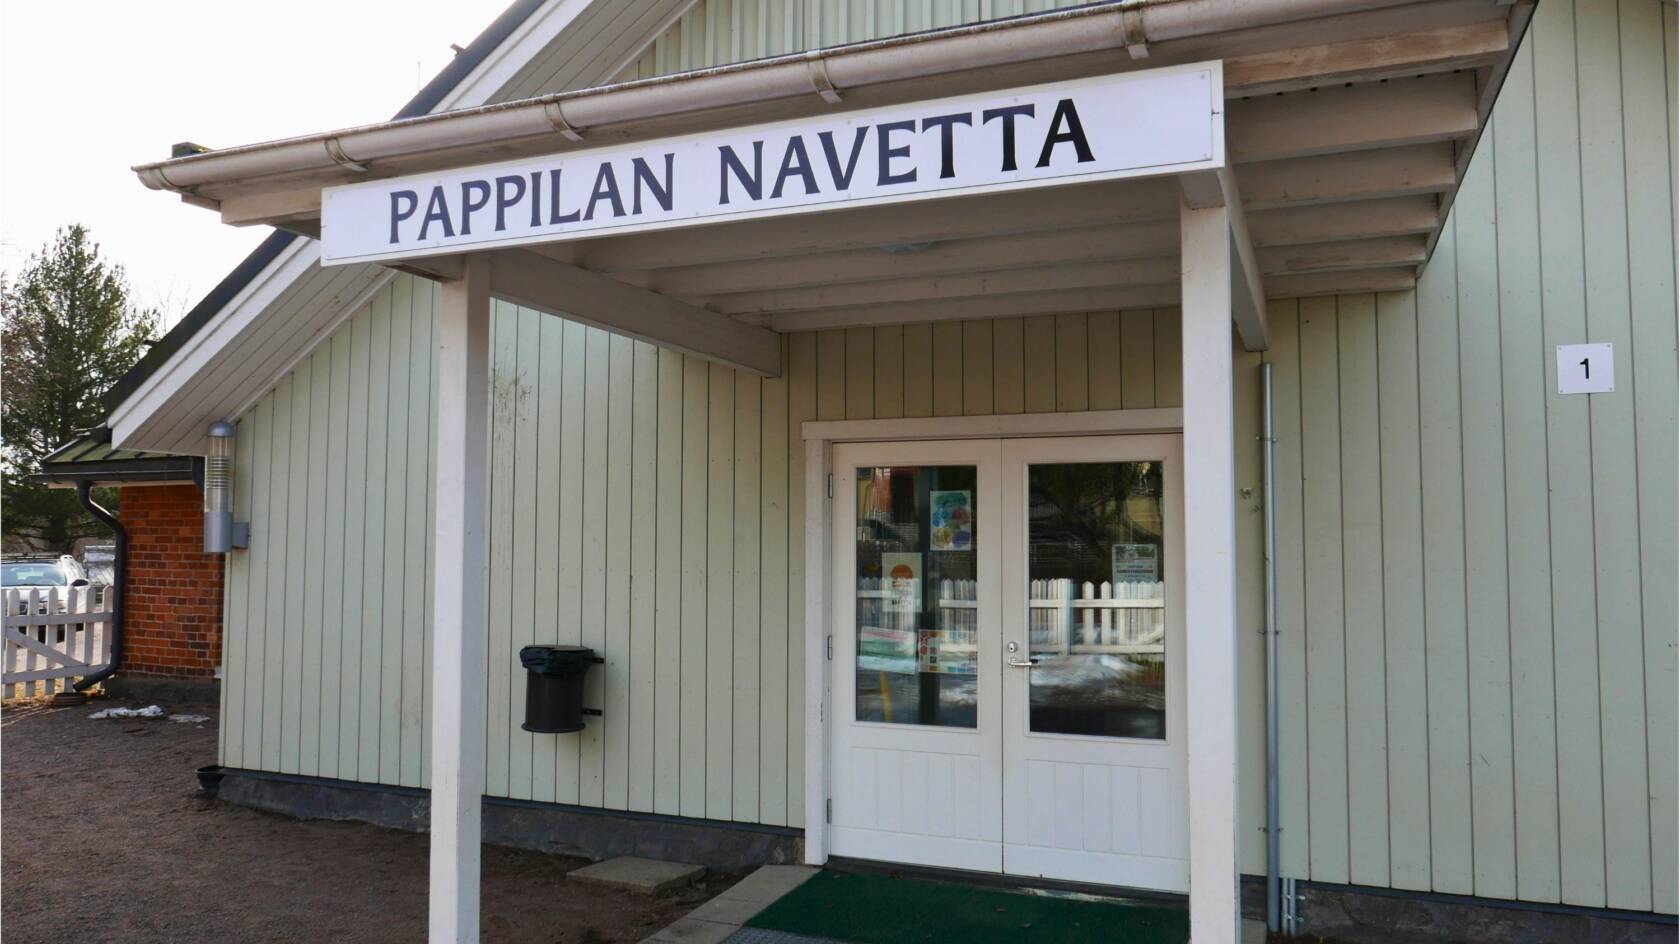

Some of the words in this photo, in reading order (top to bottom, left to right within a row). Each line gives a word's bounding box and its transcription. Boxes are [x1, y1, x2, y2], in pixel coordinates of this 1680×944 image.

[389, 152, 675, 244] PAPPILAN
[718, 98, 1097, 205] NAVETTA
[1580, 358, 1590, 380] 1
